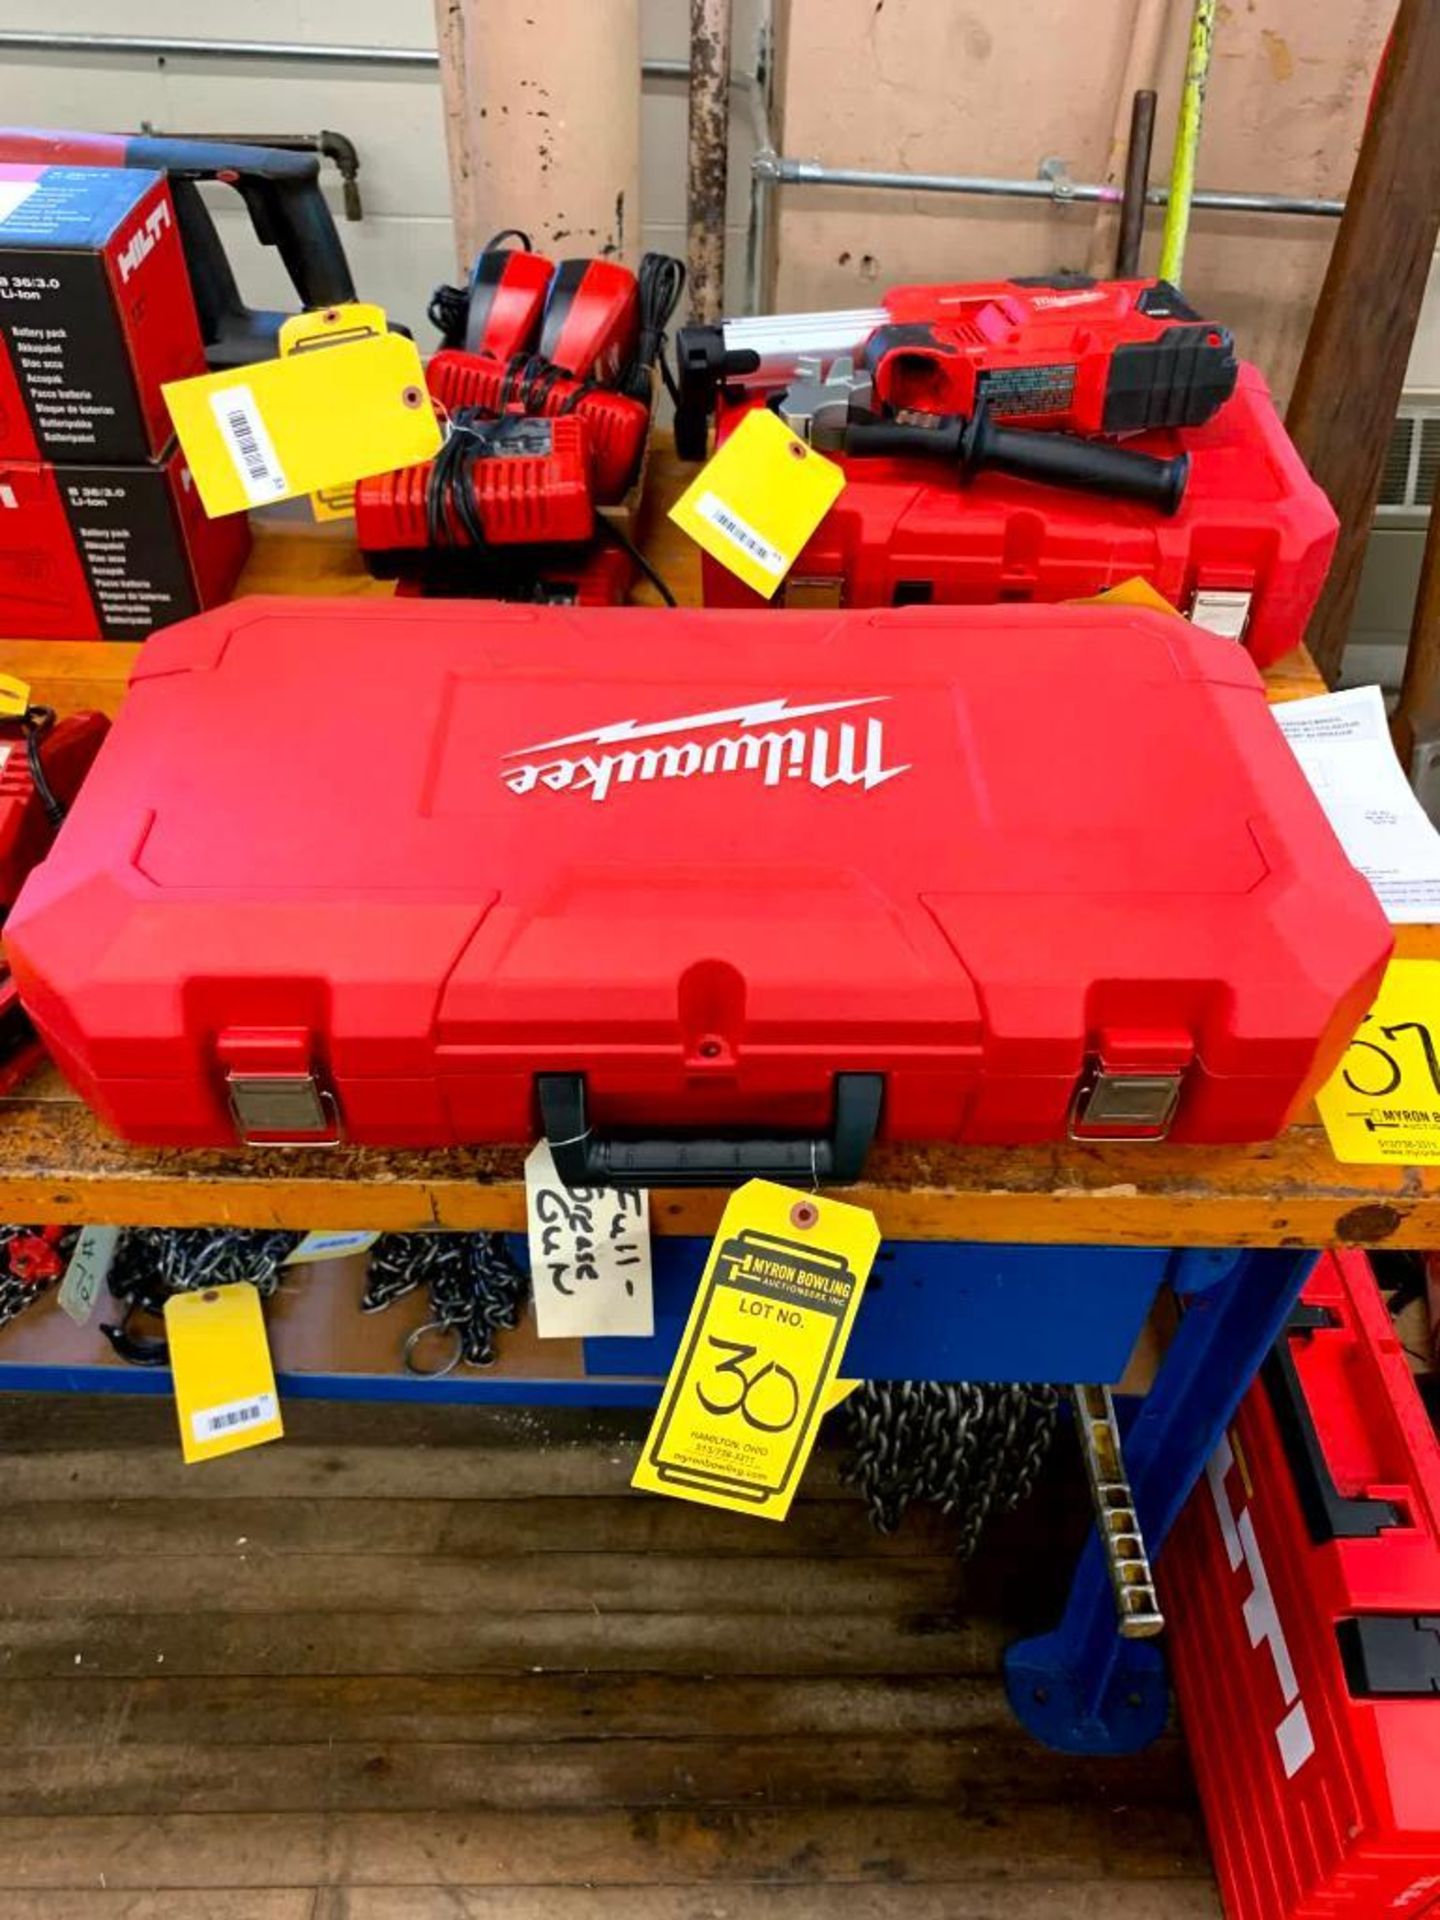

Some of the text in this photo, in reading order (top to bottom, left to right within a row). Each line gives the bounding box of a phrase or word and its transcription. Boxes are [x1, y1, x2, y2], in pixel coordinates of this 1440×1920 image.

[117, 199, 171, 284] HILTI
[12, 276, 60, 289] 36/3.0
[12, 326, 67, 340] Battery pack
[67, 404, 78, 414] de
[68, 486, 126, 498] B 36/3.0
[80, 528, 131, 540] Battery pack
[500, 717, 912, 802] Milwaukee
[1381, 1109, 1430, 1124] MYRON
[752, 1258, 851, 1298] MYRON BOWLING
[739, 1297, 804, 1329] LOT NO.
[695, 1334, 800, 1433] 30
[743, 1443, 769, 1456] OHIO
